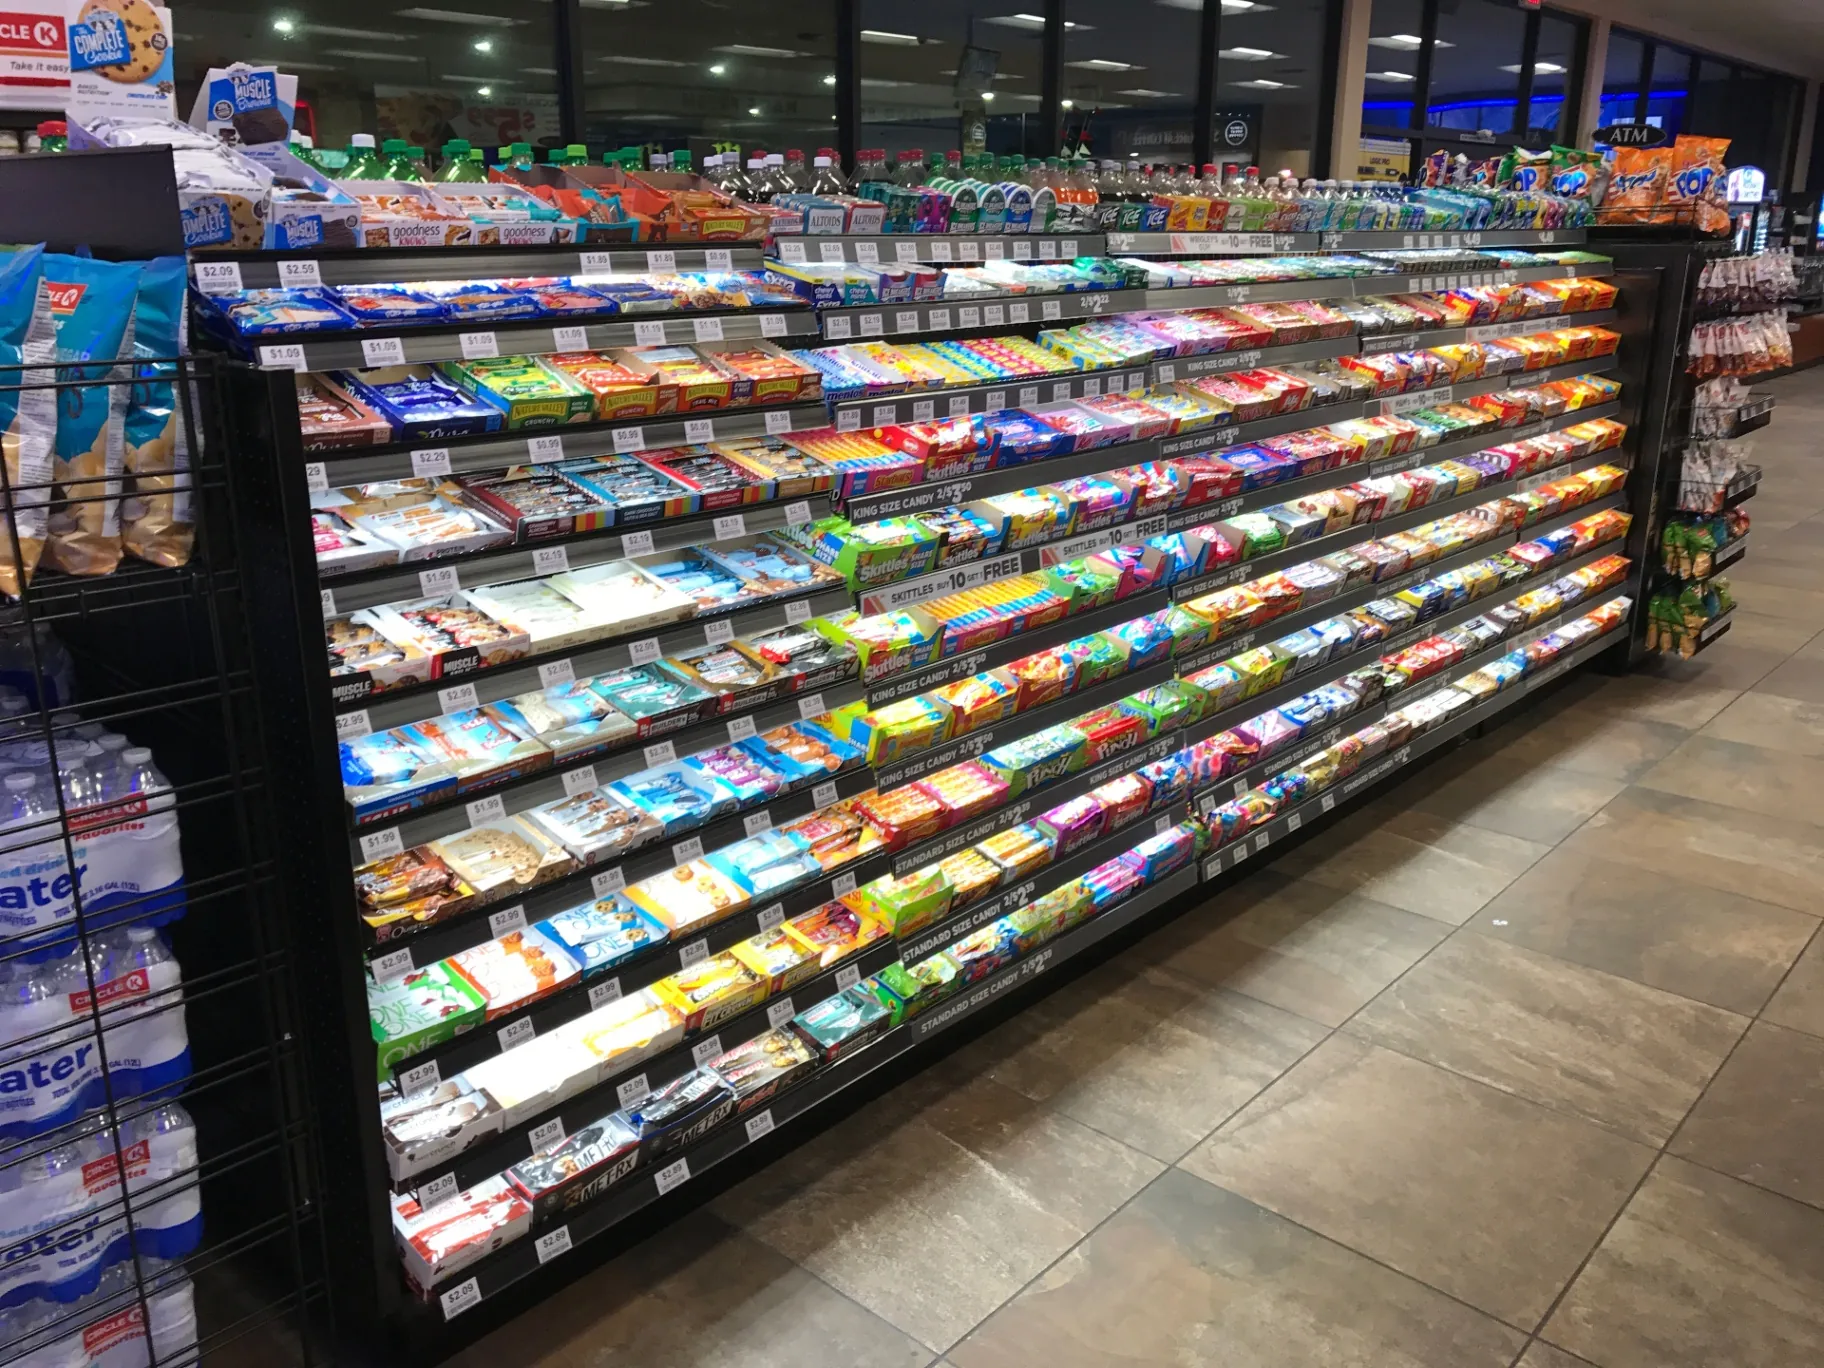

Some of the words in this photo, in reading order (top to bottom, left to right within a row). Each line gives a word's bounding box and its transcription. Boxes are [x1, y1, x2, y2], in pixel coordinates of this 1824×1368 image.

[74, 30, 124, 54] COMPLETE
[84, 50, 123, 64] Cookie
[11, 61, 33, 71] Take
[35, 61, 43, 71] it
[47, 63, 69, 73] easy
[235, 79, 272, 99] MUSCLE
[1610, 127, 1648, 143] ATM
[811, 216, 841, 226] ALTOIDS
[853, 214, 880, 225] ALTOIDS
[1100, 208, 1120, 224] ICE
[1122, 209, 1141, 224] ICE
[1147, 210, 1166, 226] ICE
[288, 219, 319, 238] MUSCLE
[393, 224, 441, 241] goodness
[504, 226, 546, 242] goodness
[704, 222, 724, 233] NATURE
[725, 220, 745, 232] VALLEY
[1228, 235, 1239, 248] 10
[1250, 235, 1272, 248] FREE
[587, 255, 607, 265] $1.89
[654, 253, 673, 262] $1.89
[203, 266, 233, 277] $2.09
[286, 264, 314, 276] $2.59
[764, 271, 795, 292] Extra
[700, 320, 718, 329] $1.19
[766, 317, 784, 326] $1.09
[832, 318, 849, 327] $2.19
[864, 317, 880, 325] $2.19
[559, 329, 582, 339] $1.09
[641, 324, 661, 334] $1.19
[370, 342, 397, 352] $1.09
[467, 335, 493, 345] $1.09
[270, 348, 300, 359] $1.09
[1188, 362, 1204, 371] KING
[1204, 360, 1216, 368] SIZE
[1217, 357, 1237, 367] CANDY
[688, 387, 706, 397] NATURE
[707, 385, 728, 396] VALLEY
[827, 390, 864, 400] mentos
[606, 394, 630, 408] NATURE
[631, 392, 655, 405] VALLEY
[514, 404, 539, 419] NATURE
[540, 402, 567, 416] VALLEY
[616, 407, 645, 416] CRUNCHY
[525, 417, 556, 426] CRUNCHY
[689, 422, 709, 431] $0.99
[617, 430, 639, 440] $0.99
[536, 439, 560, 449] $0.99
[1163, 444, 1179, 454] KING
[1180, 441, 1192, 451] SIZE
[1194, 436, 1216, 448] CANDY
[420, 452, 445, 462] $2.29
[973, 455, 991, 464] SHARE
[926, 461, 970, 481] Skittles
[853, 505, 878, 520] KING
[879, 500, 901, 513] SIZE
[902, 493, 935, 510] CANDY
[1136, 502, 1169, 517] Skittles
[719, 519, 739, 529] $2.19
[720, 518, 739, 527] $2.19
[1077, 515, 1111, 533] Skittles
[1169, 517, 1184, 527] KING
[1185, 513, 1197, 524] SIZE
[1198, 508, 1220, 520] CANDY
[1109, 530, 1122, 545] 10
[1135, 518, 1165, 538] FREE
[628, 535, 649, 544] $2.19
[1011, 532, 1049, 549] Skittles
[538, 550, 562, 561] $2.19
[815, 539, 840, 559] SHARE
[1063, 542, 1097, 555] SKITTLES
[815, 550, 833, 564] SIZE
[911, 550, 933, 563] SHARE
[943, 550, 979, 569] Skittles
[860, 557, 907, 581] Skittles
[911, 560, 926, 569] SIZE
[425, 572, 451, 582] $1.99
[891, 585, 934, 604] SKITTLES
[937, 582, 949, 591] BUY
[949, 572, 966, 589] 10
[967, 574, 979, 582] GET
[983, 558, 1020, 580] FREE
[1177, 587, 1193, 598] KING
[1194, 584, 1206, 595] SIZE
[1207, 579, 1229, 591] CANDY
[915, 644, 933, 654] SHARE
[444, 655, 478, 672] MUSCLE
[915, 652, 929, 662] SIZE
[1181, 660, 1196, 670] KING
[1196, 656, 1209, 667] SIZE
[1210, 649, 1232, 662] CANDY
[864, 655, 912, 682] Skittles
[332, 681, 371, 695] MUSCLE
[447, 688, 472, 700] $2.99
[871, 686, 895, 703] KING
[896, 680, 917, 695] SIZE
[918, 670, 950, 689] CANDY
[336, 715, 364, 728] $2.99
[1096, 731, 1140, 759] PUNCH
[1264, 756, 1293, 775] STANDARD
[1293, 749, 1304, 762] SIZE
[1303, 740, 1322, 755] CANDY
[879, 771, 903, 787] KING
[905, 762, 924, 778] SIZE
[926, 750, 957, 772] CANDY
[1026, 754, 1072, 789] PUNCH
[1089, 770, 1108, 785] KING
[1109, 763, 1122, 777] SIZE
[1124, 752, 1148, 772] CANDY
[1343, 774, 1368, 794] STANDARD
[474, 800, 499, 813] $1.99
[75, 821, 145, 841] Favorites
[368, 832, 395, 847] $1.99
[679, 840, 698, 853] $2.99
[895, 846, 944, 873] STANDARD
[946, 836, 965, 853] SIZE
[967, 821, 996, 844] CANDY
[597, 871, 619, 884] $2.99
[495, 910, 519, 924] $2.99
[903, 930, 951, 961] STANDARD
[953, 919, 972, 936] SIZE
[974, 904, 1001, 926] CANDY
[586, 934, 629, 960] ONE
[685, 943, 704, 955] $2.99
[381, 953, 408, 968] $2.99
[594, 983, 615, 996] $2.99
[921, 1000, 968, 1033] STANDARD
[970, 988, 989, 1005] SIZE
[990, 972, 1019, 994] CANDY
[507, 1020, 530, 1035] $2.99
[384, 1030, 442, 1067] ONE
[408, 1065, 435, 1083] $2.99
[622, 1078, 644, 1094] $2.09
[533, 1122, 558, 1140] $2.09
[682, 1102, 729, 1146] MET-RX
[580, 1153, 635, 1202] MET-RX
[661, 1164, 682, 1181] $2.89
[427, 1176, 454, 1196] $2.09
[542, 1230, 567, 1249] $2.89
[448, 1283, 474, 1303] $2.09
